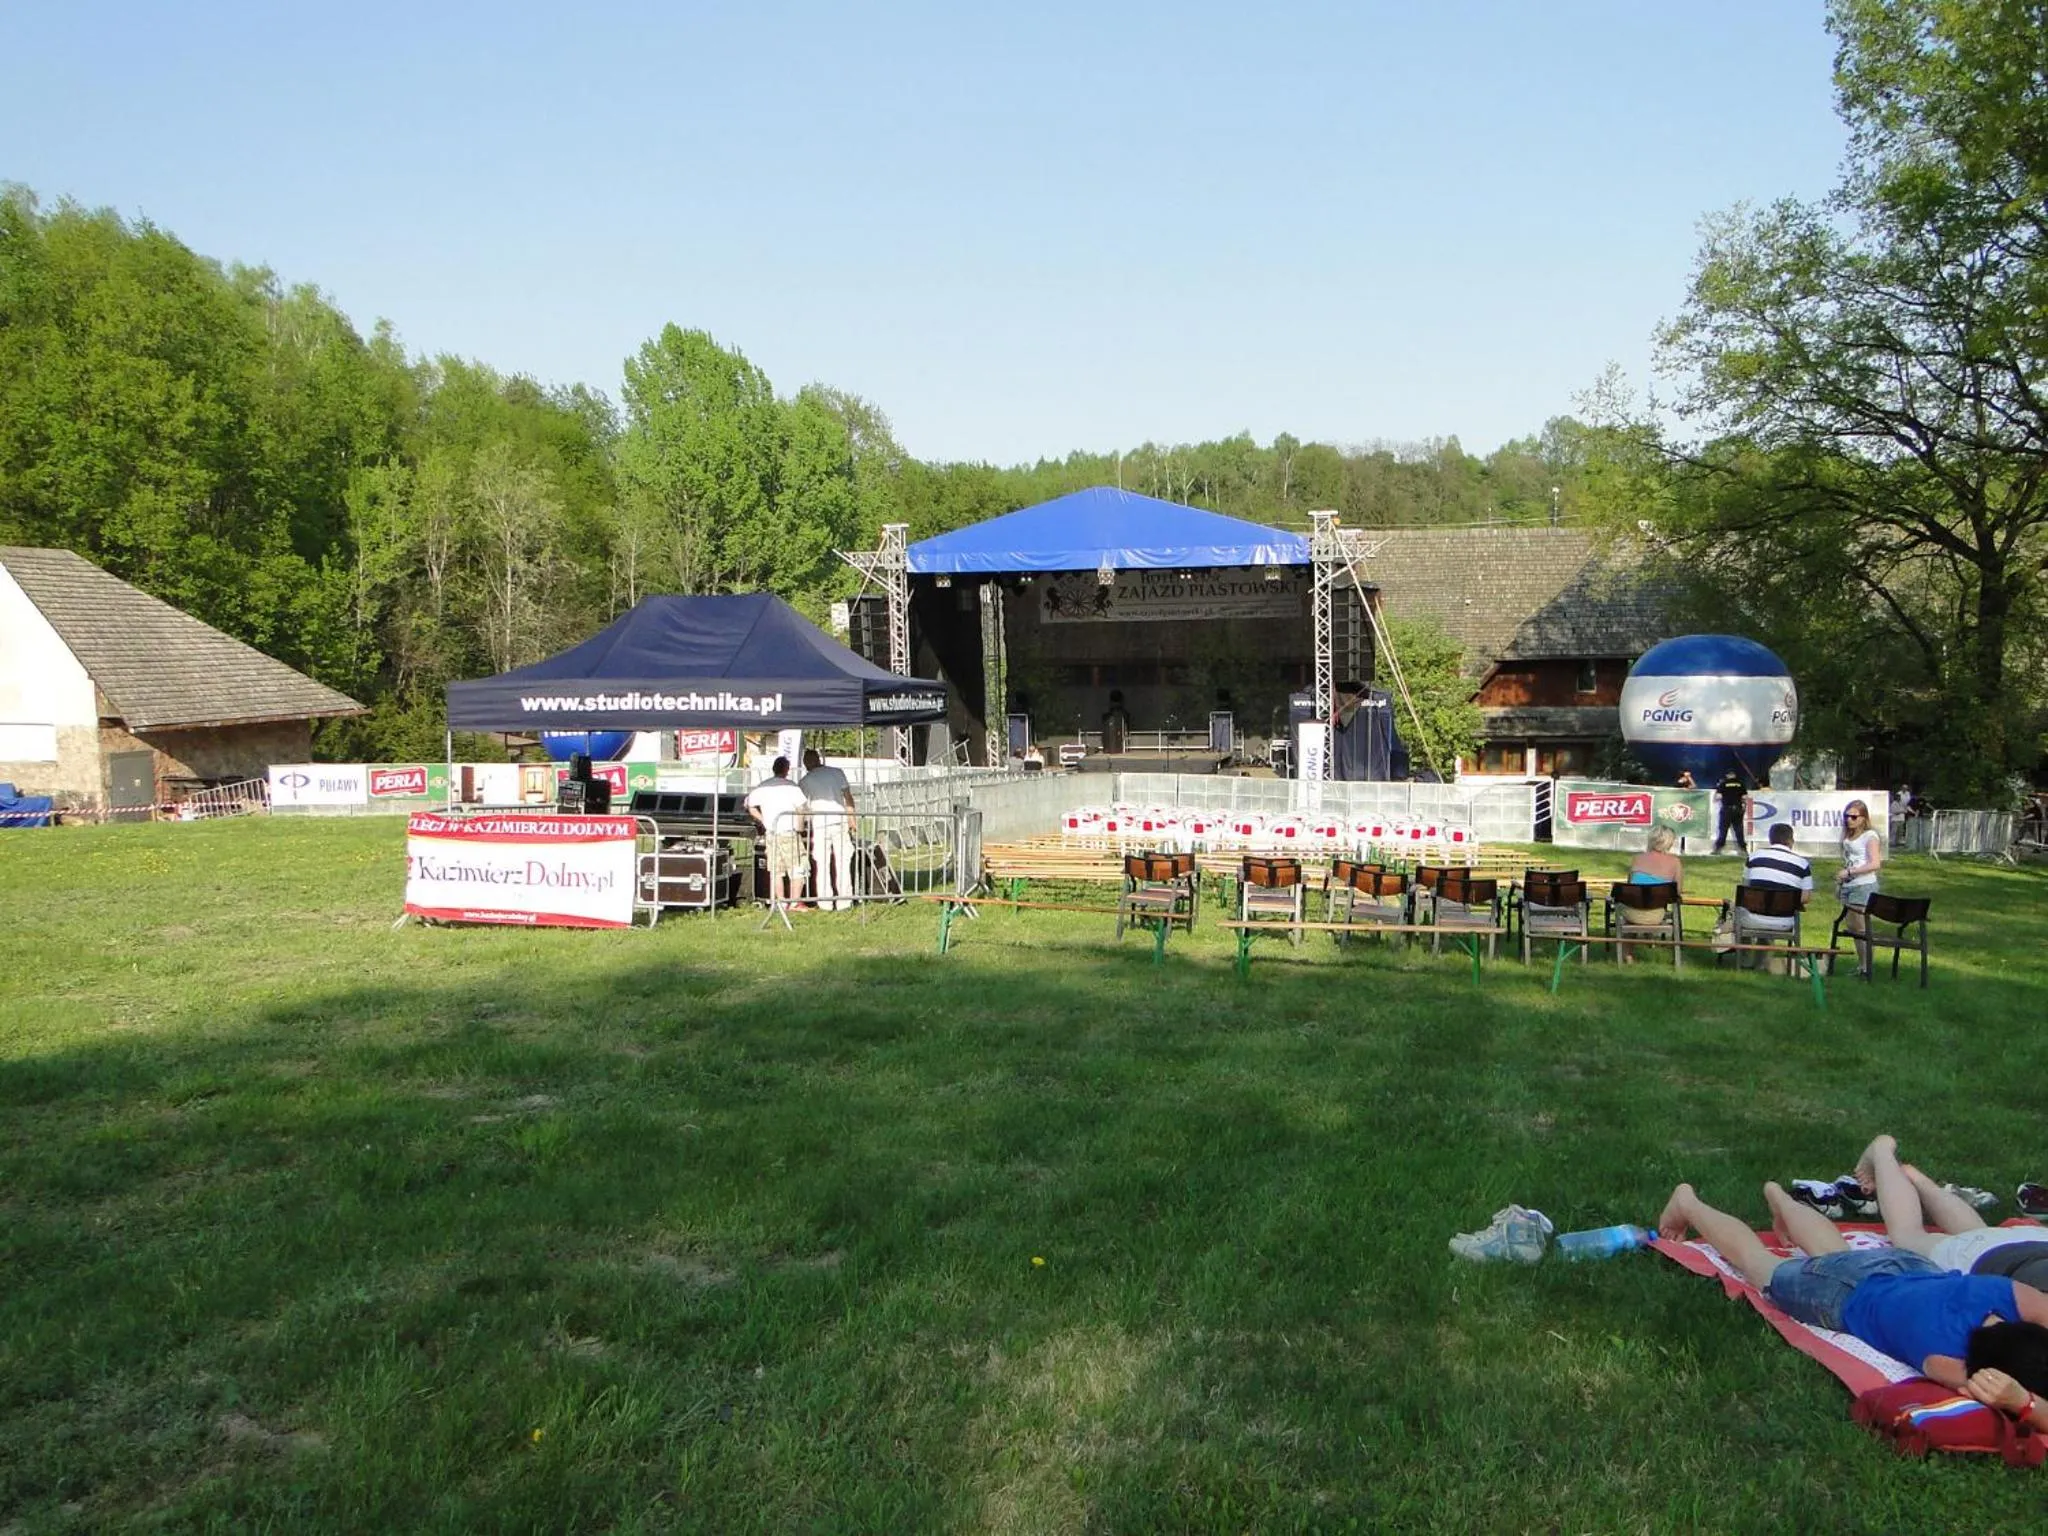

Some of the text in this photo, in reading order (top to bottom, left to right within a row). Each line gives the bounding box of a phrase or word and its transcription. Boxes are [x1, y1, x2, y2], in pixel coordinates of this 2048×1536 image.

[1117, 579, 1299, 601] ZAJAZD PIASTOWSKI
[520, 692, 782, 716] www.studiotechnika.pl
[1642, 709, 1694, 722] PGNiG
[1771, 710, 1795, 724] PGN
[375, 773, 423, 790] PERŁA
[1574, 799, 1646, 818] PERŁA
[1791, 809, 1846, 827] PUŁAW
[464, 820, 559, 835] KAZIMIERZU
[562, 822, 629, 836] DOLNYM
[417, 856, 614, 893] KazimierzDolny.pl
